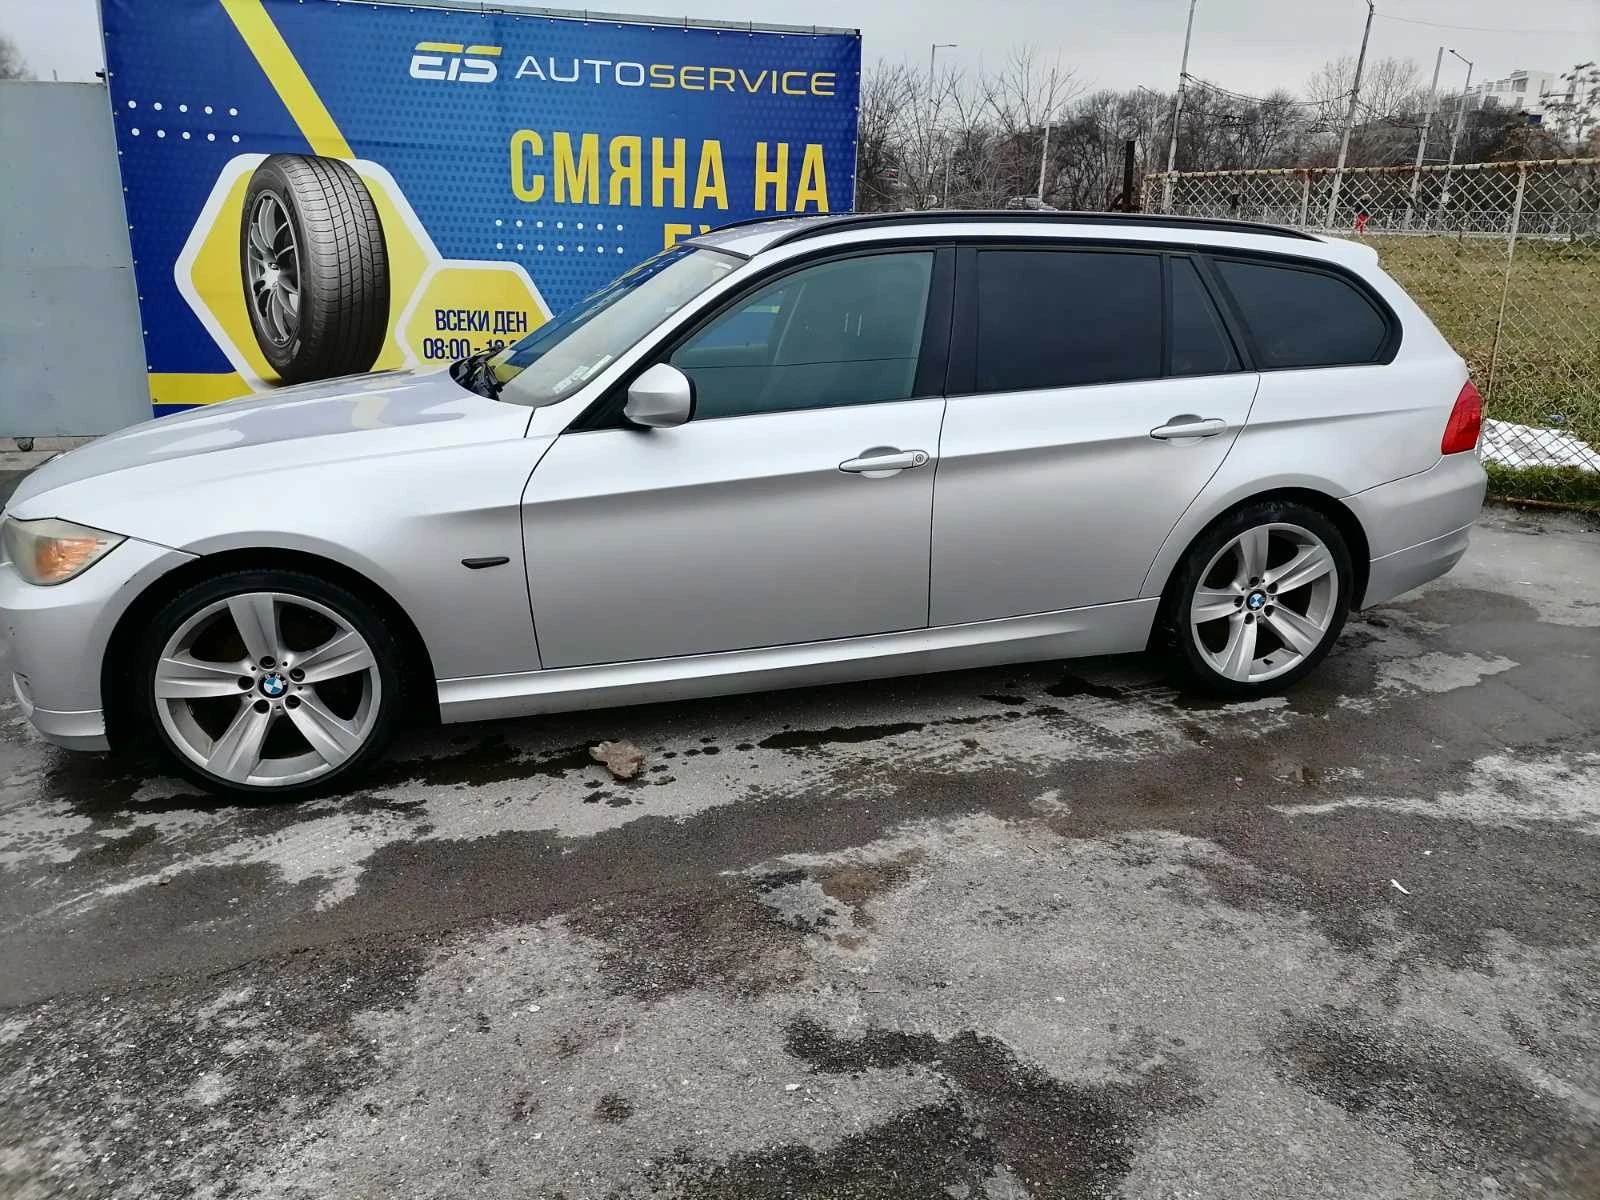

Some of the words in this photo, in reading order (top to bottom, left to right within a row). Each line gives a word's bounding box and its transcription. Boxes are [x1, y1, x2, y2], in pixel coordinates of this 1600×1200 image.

[409, 42, 502, 83] EIS
[515, 55, 836, 96] AUTOSERVICE
[510, 129, 729, 210] СМЯНА
[754, 142, 829, 213] НА
[435, 309, 490, 332] ВСЕКИ
[493, 311, 528, 334] ДЕН
[423, 338, 471, 359] 08:00
